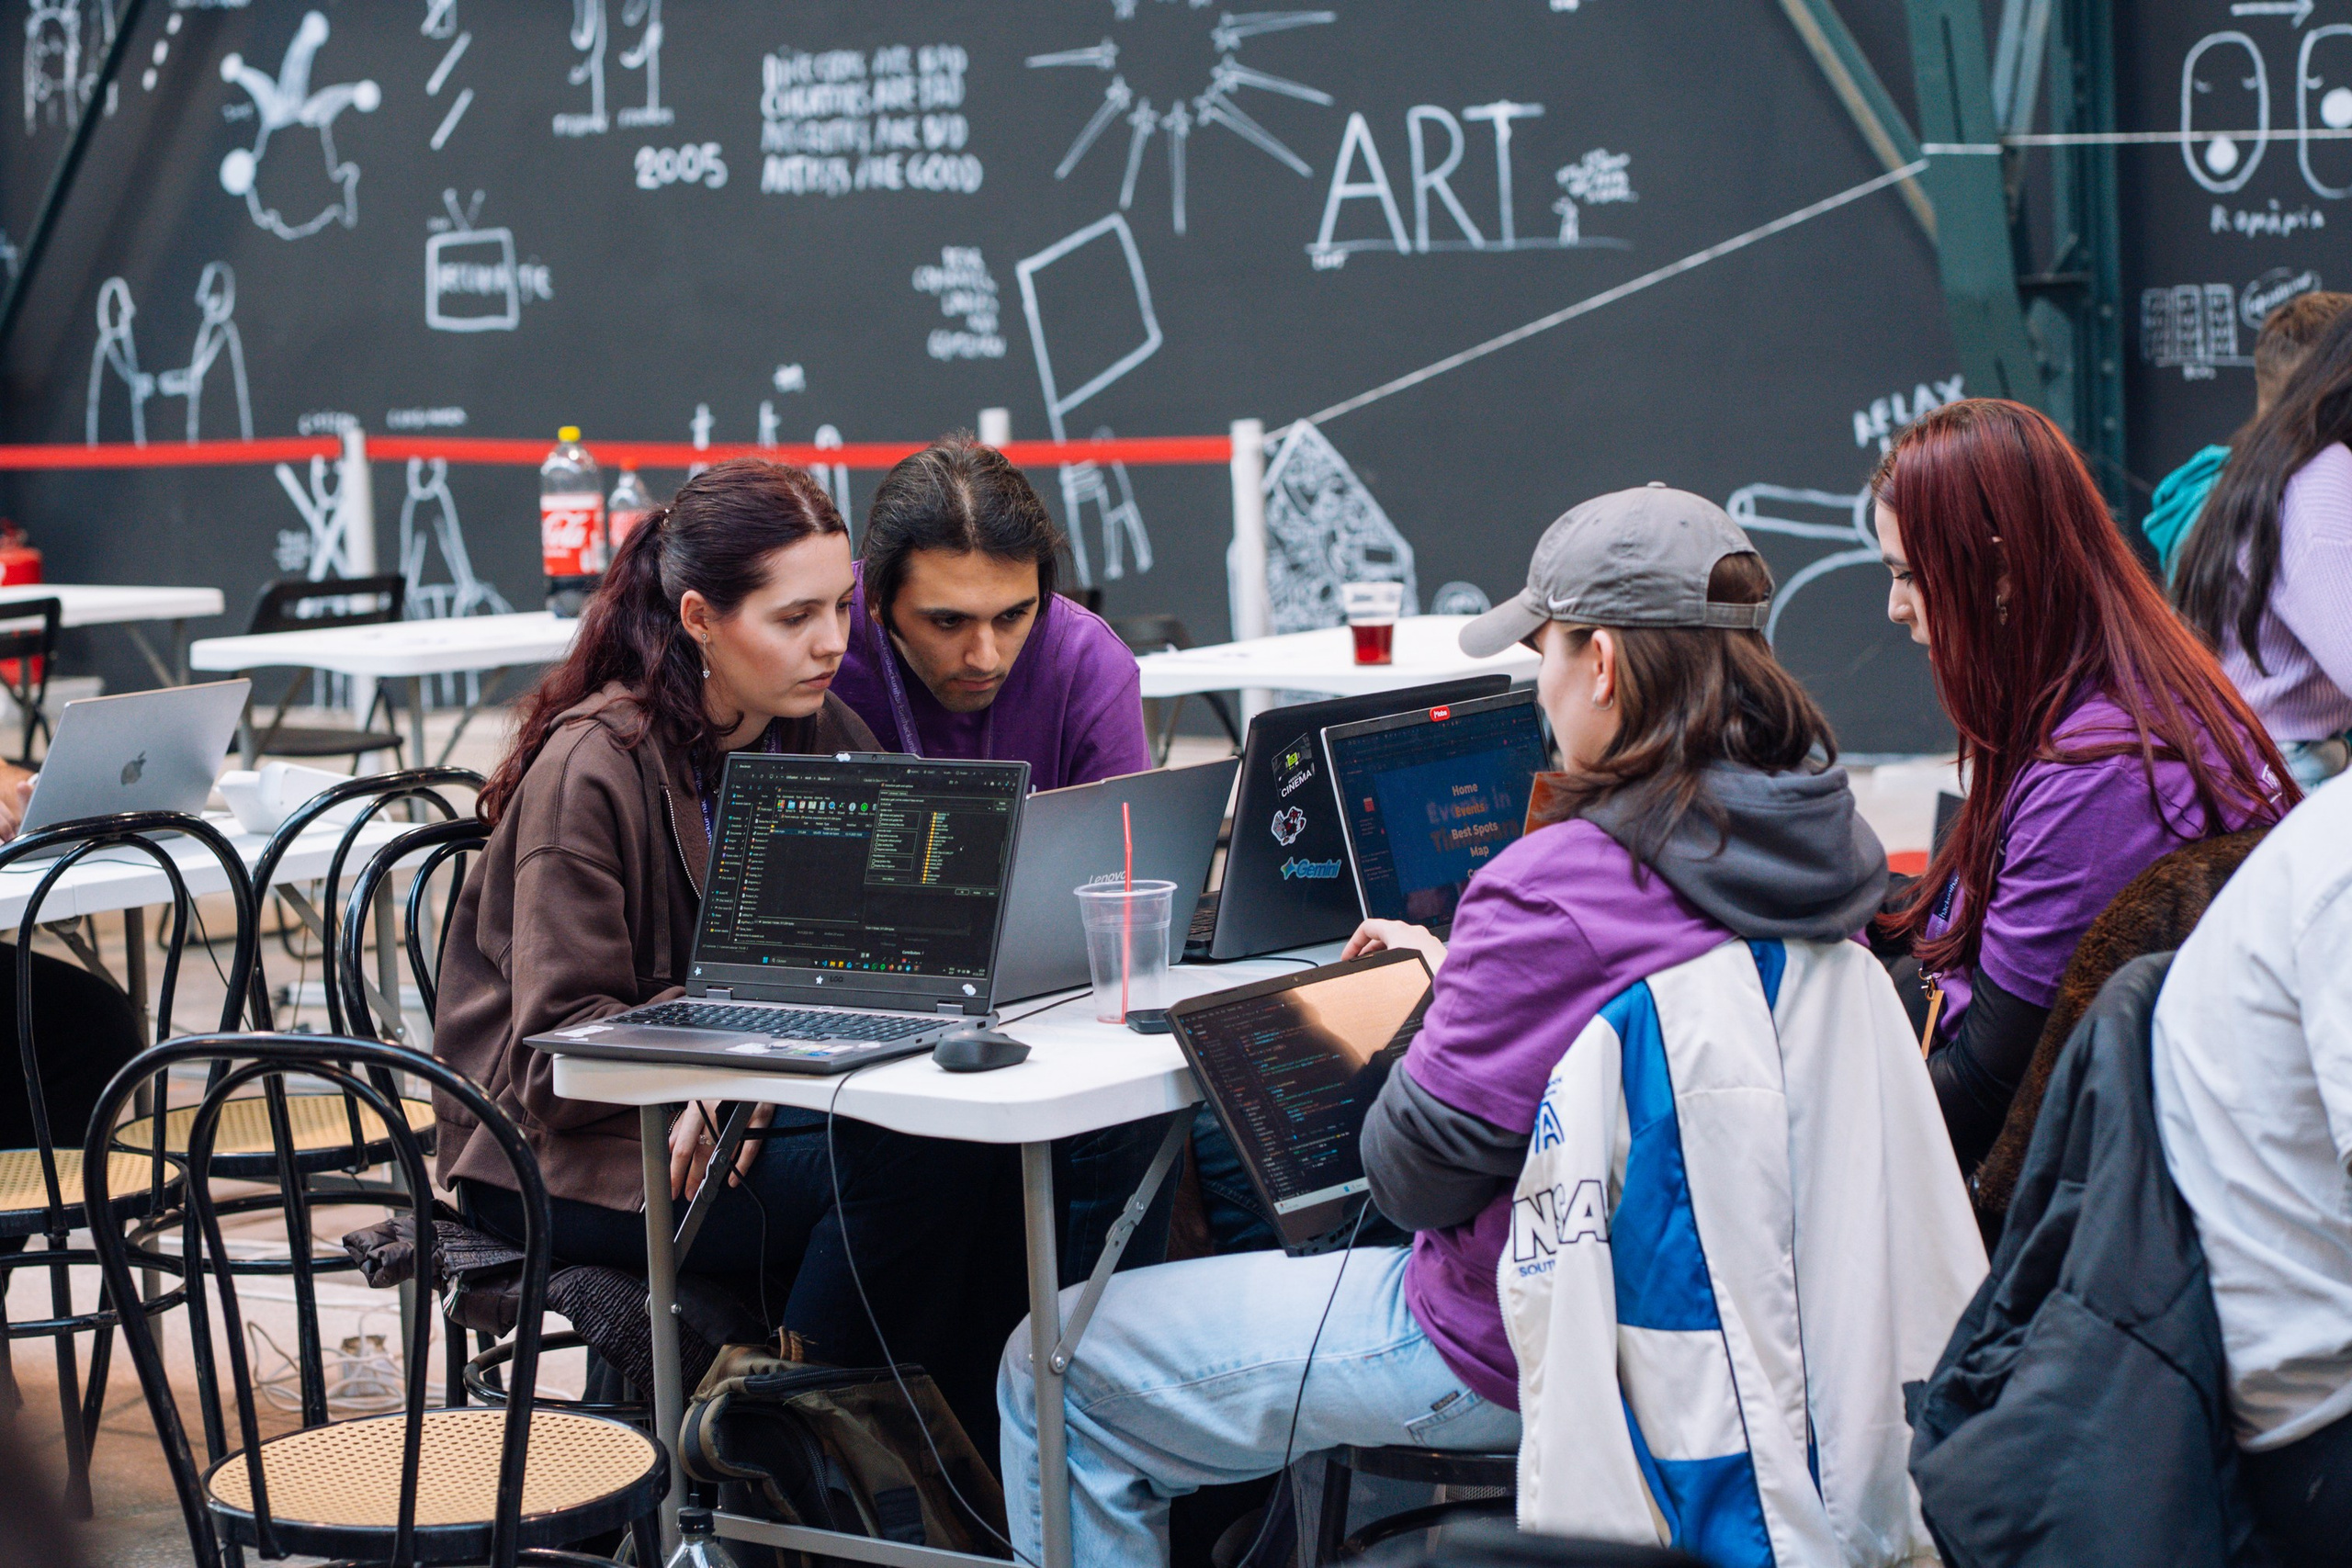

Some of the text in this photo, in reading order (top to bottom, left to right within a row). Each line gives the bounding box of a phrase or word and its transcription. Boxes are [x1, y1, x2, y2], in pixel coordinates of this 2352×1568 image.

[634, 141, 729, 189] 2005
[906, 152, 984, 194] GOOD
[1316, 99, 1545, 254] ART
[1281, 770, 1313, 797] CINEMA
[1452, 784, 1478, 796] Home
[1455, 804, 1486, 818] Events
[1452, 822, 1498, 840] Best Spots
[1470, 846, 1489, 857] Map
[1296, 859, 1341, 878] Gemini
